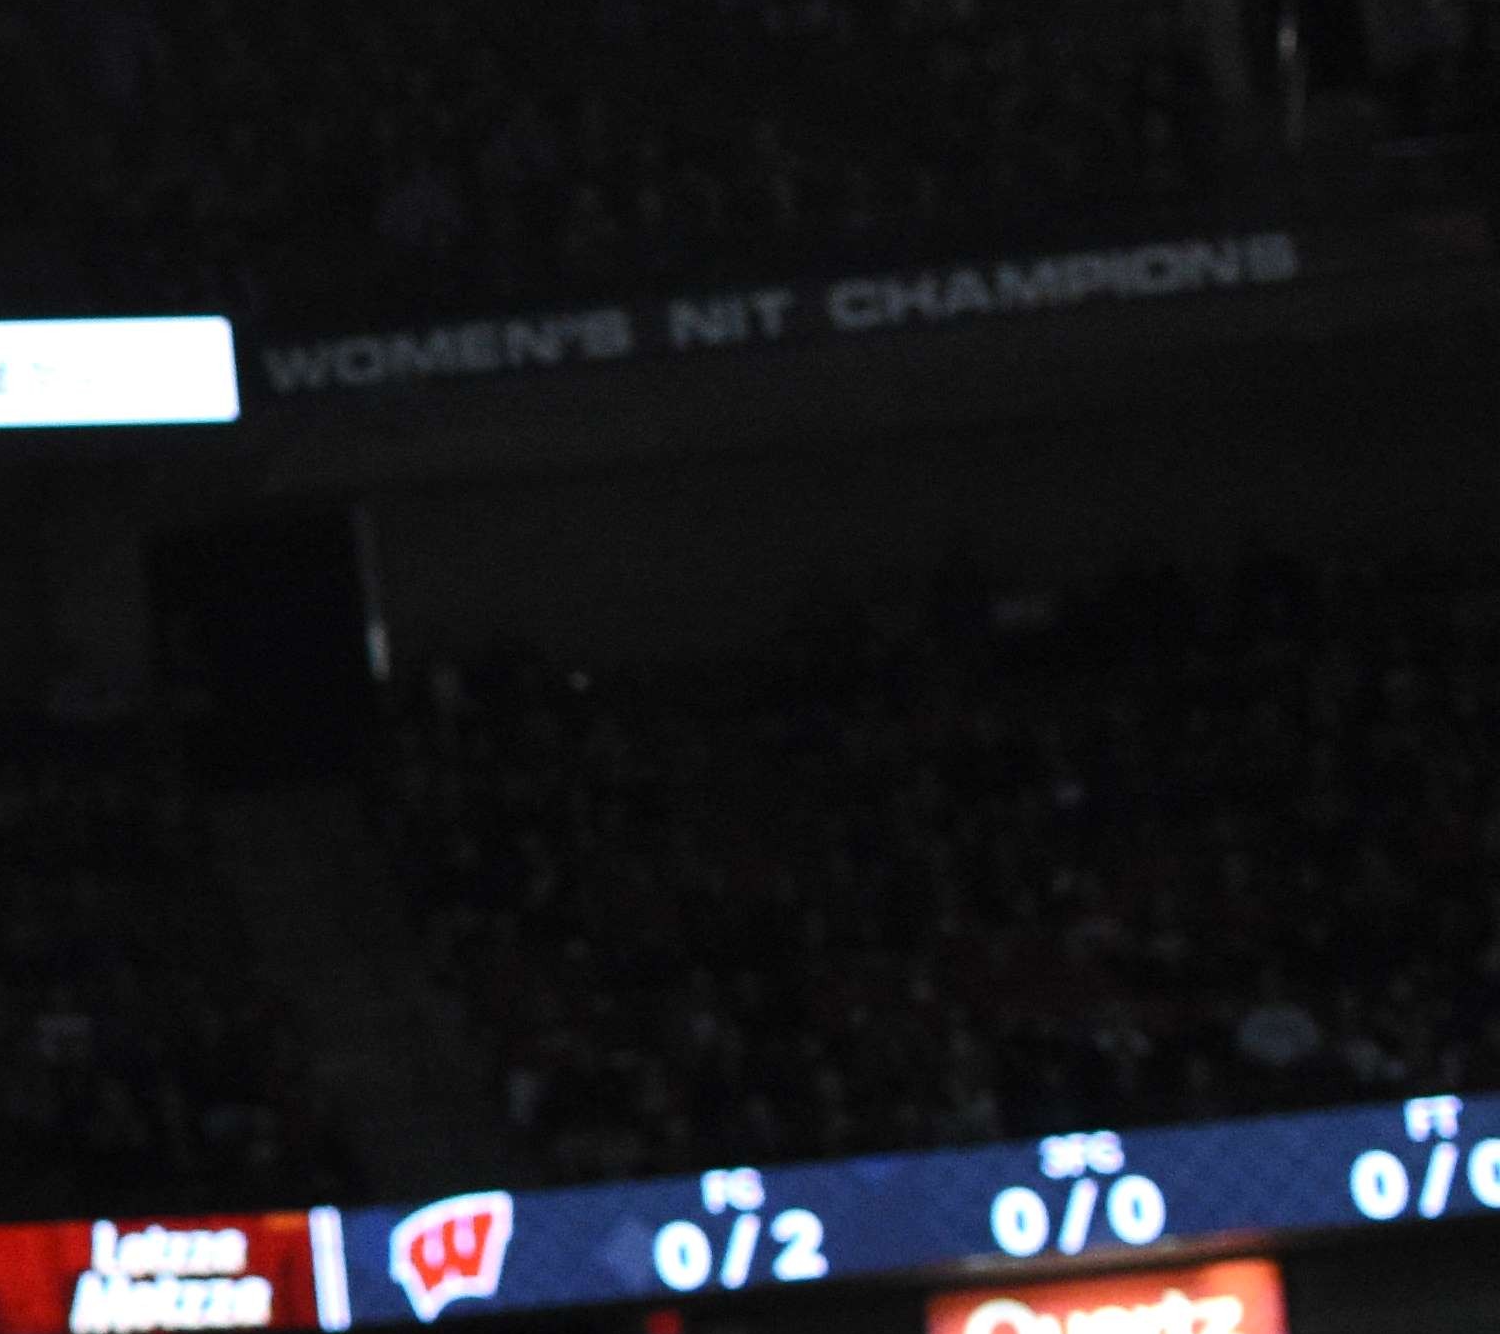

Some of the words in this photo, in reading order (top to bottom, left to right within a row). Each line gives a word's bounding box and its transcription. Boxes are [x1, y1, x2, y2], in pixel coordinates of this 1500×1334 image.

[262, 307, 633, 394] WOMEN'S
[827, 231, 1299, 333] CHAMPIONS
[652, 1207, 829, 1293] 0/2
[990, 1173, 1167, 1258] 0/0
